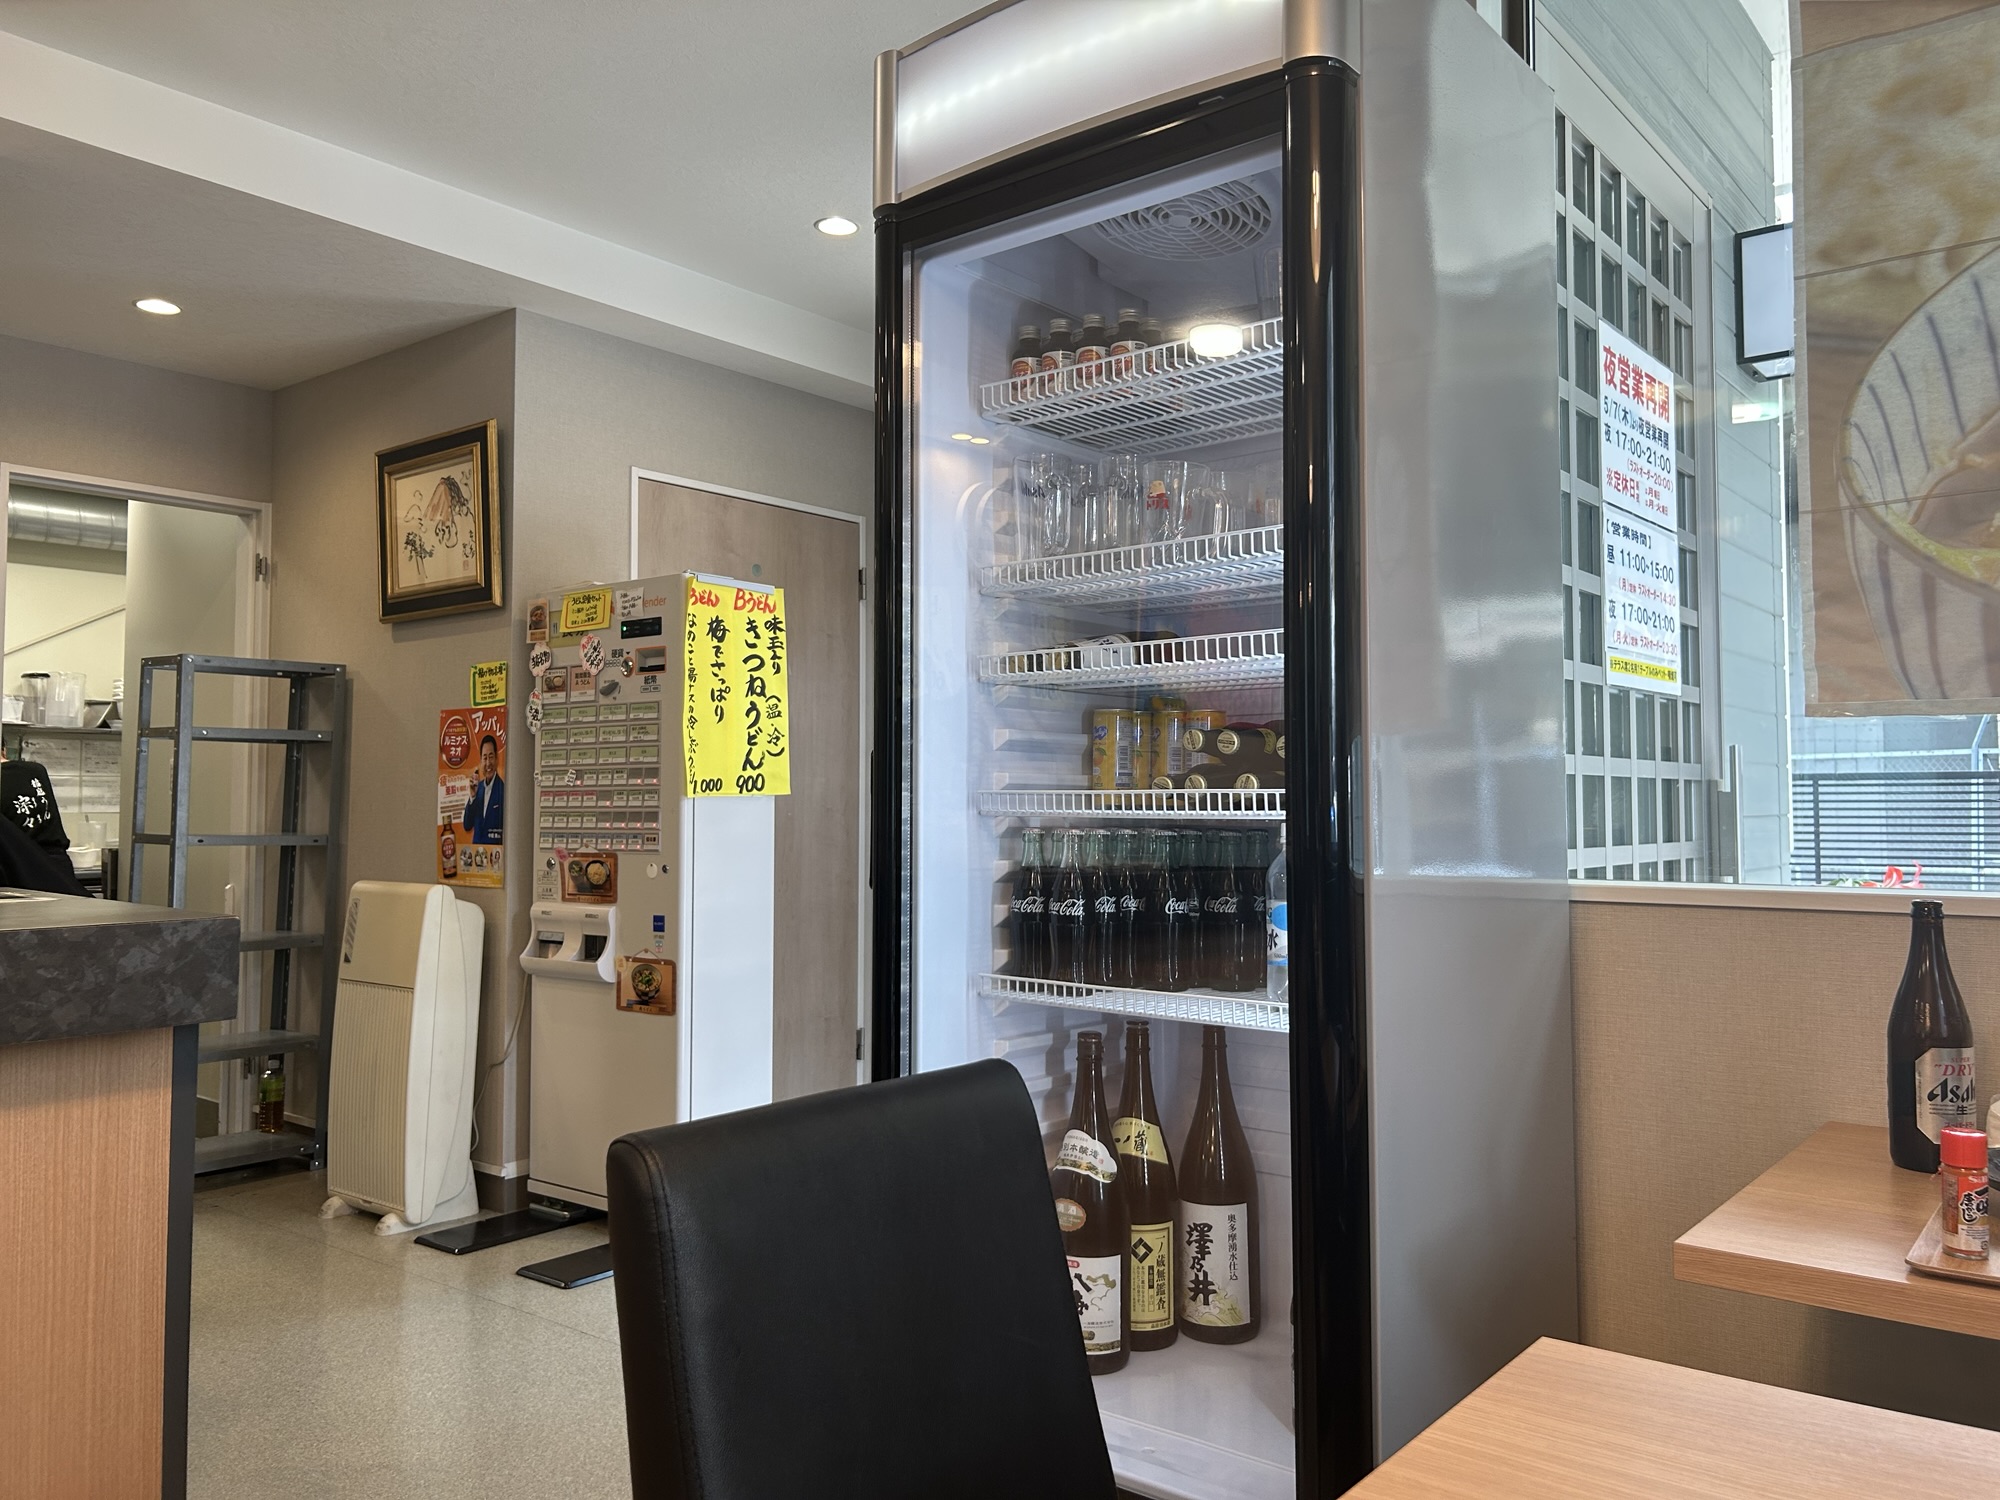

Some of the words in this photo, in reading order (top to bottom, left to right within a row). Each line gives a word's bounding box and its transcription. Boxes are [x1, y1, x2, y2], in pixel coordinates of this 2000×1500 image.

[1603, 345, 1669, 423] 夜営業再開
[1605, 423, 1612, 444] 夜
[1607, 518, 1652, 550] 【営業時間】
[1607, 544, 1615, 564] 昼
[644, 595, 667, 608] ender
[734, 587, 777, 614] Bうどん
[1608, 599, 1616, 620] 夜
[611, 648, 624, 658] 硬貨
[764, 614, 786, 676] 味玉入り
[644, 675, 657, 685] 紙幣
[706, 614, 731, 724] 梅でさっぱり
[742, 616, 768, 771] きつねうどん
[471, 711, 507, 744] アッパレ!!
[444, 735, 467, 746] ルミナス
[450, 746, 462, 756] ネオ
[735, 773, 766, 795] 900
[1927, 1077, 1976, 1103] Asah
[1956, 1104, 1968, 1115] 生
[1062, 1142, 1100, 1160] 別本醸造
[1227, 1214, 1239, 1281] 奥多摩湧水仕込
[1185, 1222, 1218, 1306] 澤乃井
